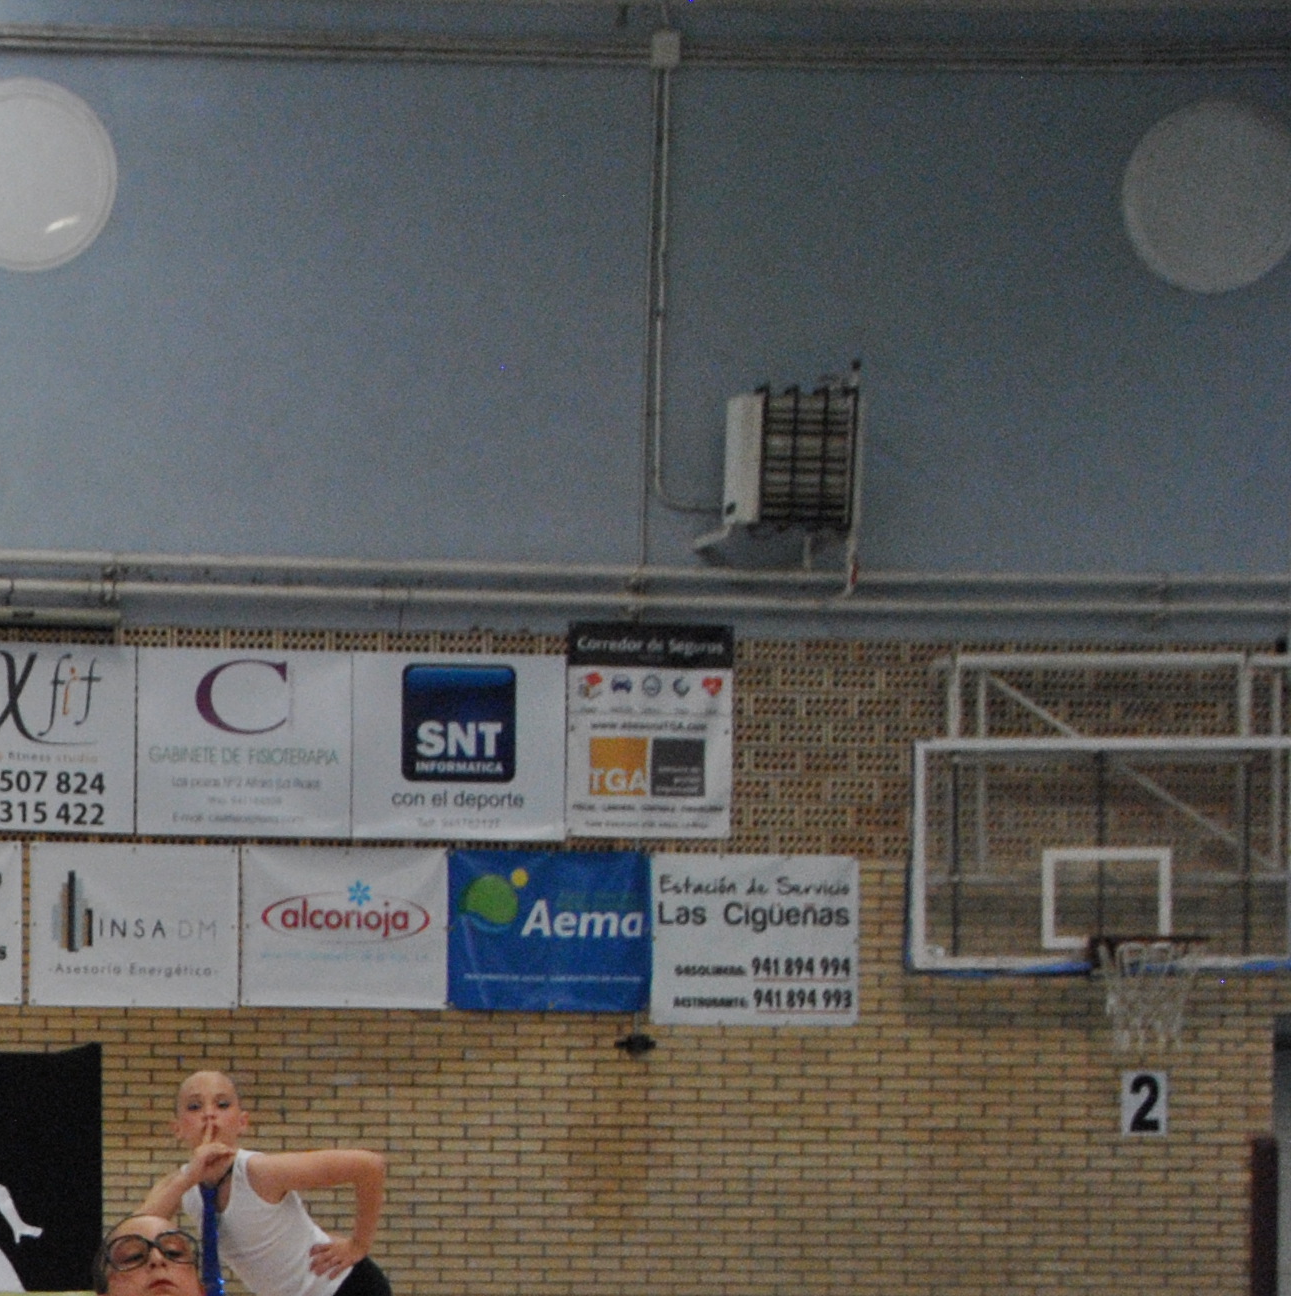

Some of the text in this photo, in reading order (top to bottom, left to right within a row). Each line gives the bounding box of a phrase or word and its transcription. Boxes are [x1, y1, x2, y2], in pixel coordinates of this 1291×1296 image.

[194, 658, 288, 735] C
[415, 720, 502, 758] SNT
[148, 746, 340, 766] GABINETE DE FISIOTERAPIA
[0, 769, 47, 792] 507
[56, 771, 105, 795] 824
[591, 767, 648, 792] TGA
[391, 789, 524, 810] con el deporte
[0, 800, 47, 823] 315
[56, 802, 104, 825] 422
[659, 874, 851, 896] Estación de Servicio
[99, 918, 167, 939] INSA
[520, 898, 644, 938] Aema
[658, 899, 851, 933] Las Cigüeñas
[751, 956, 780, 978] 941
[784, 956, 815, 978] 894
[820, 956, 851, 978] 994
[753, 988, 782, 1009] 941
[786, 988, 817, 1009] 894
[821, 988, 854, 1010] 993
[1130, 1073, 1159, 1134] 2
